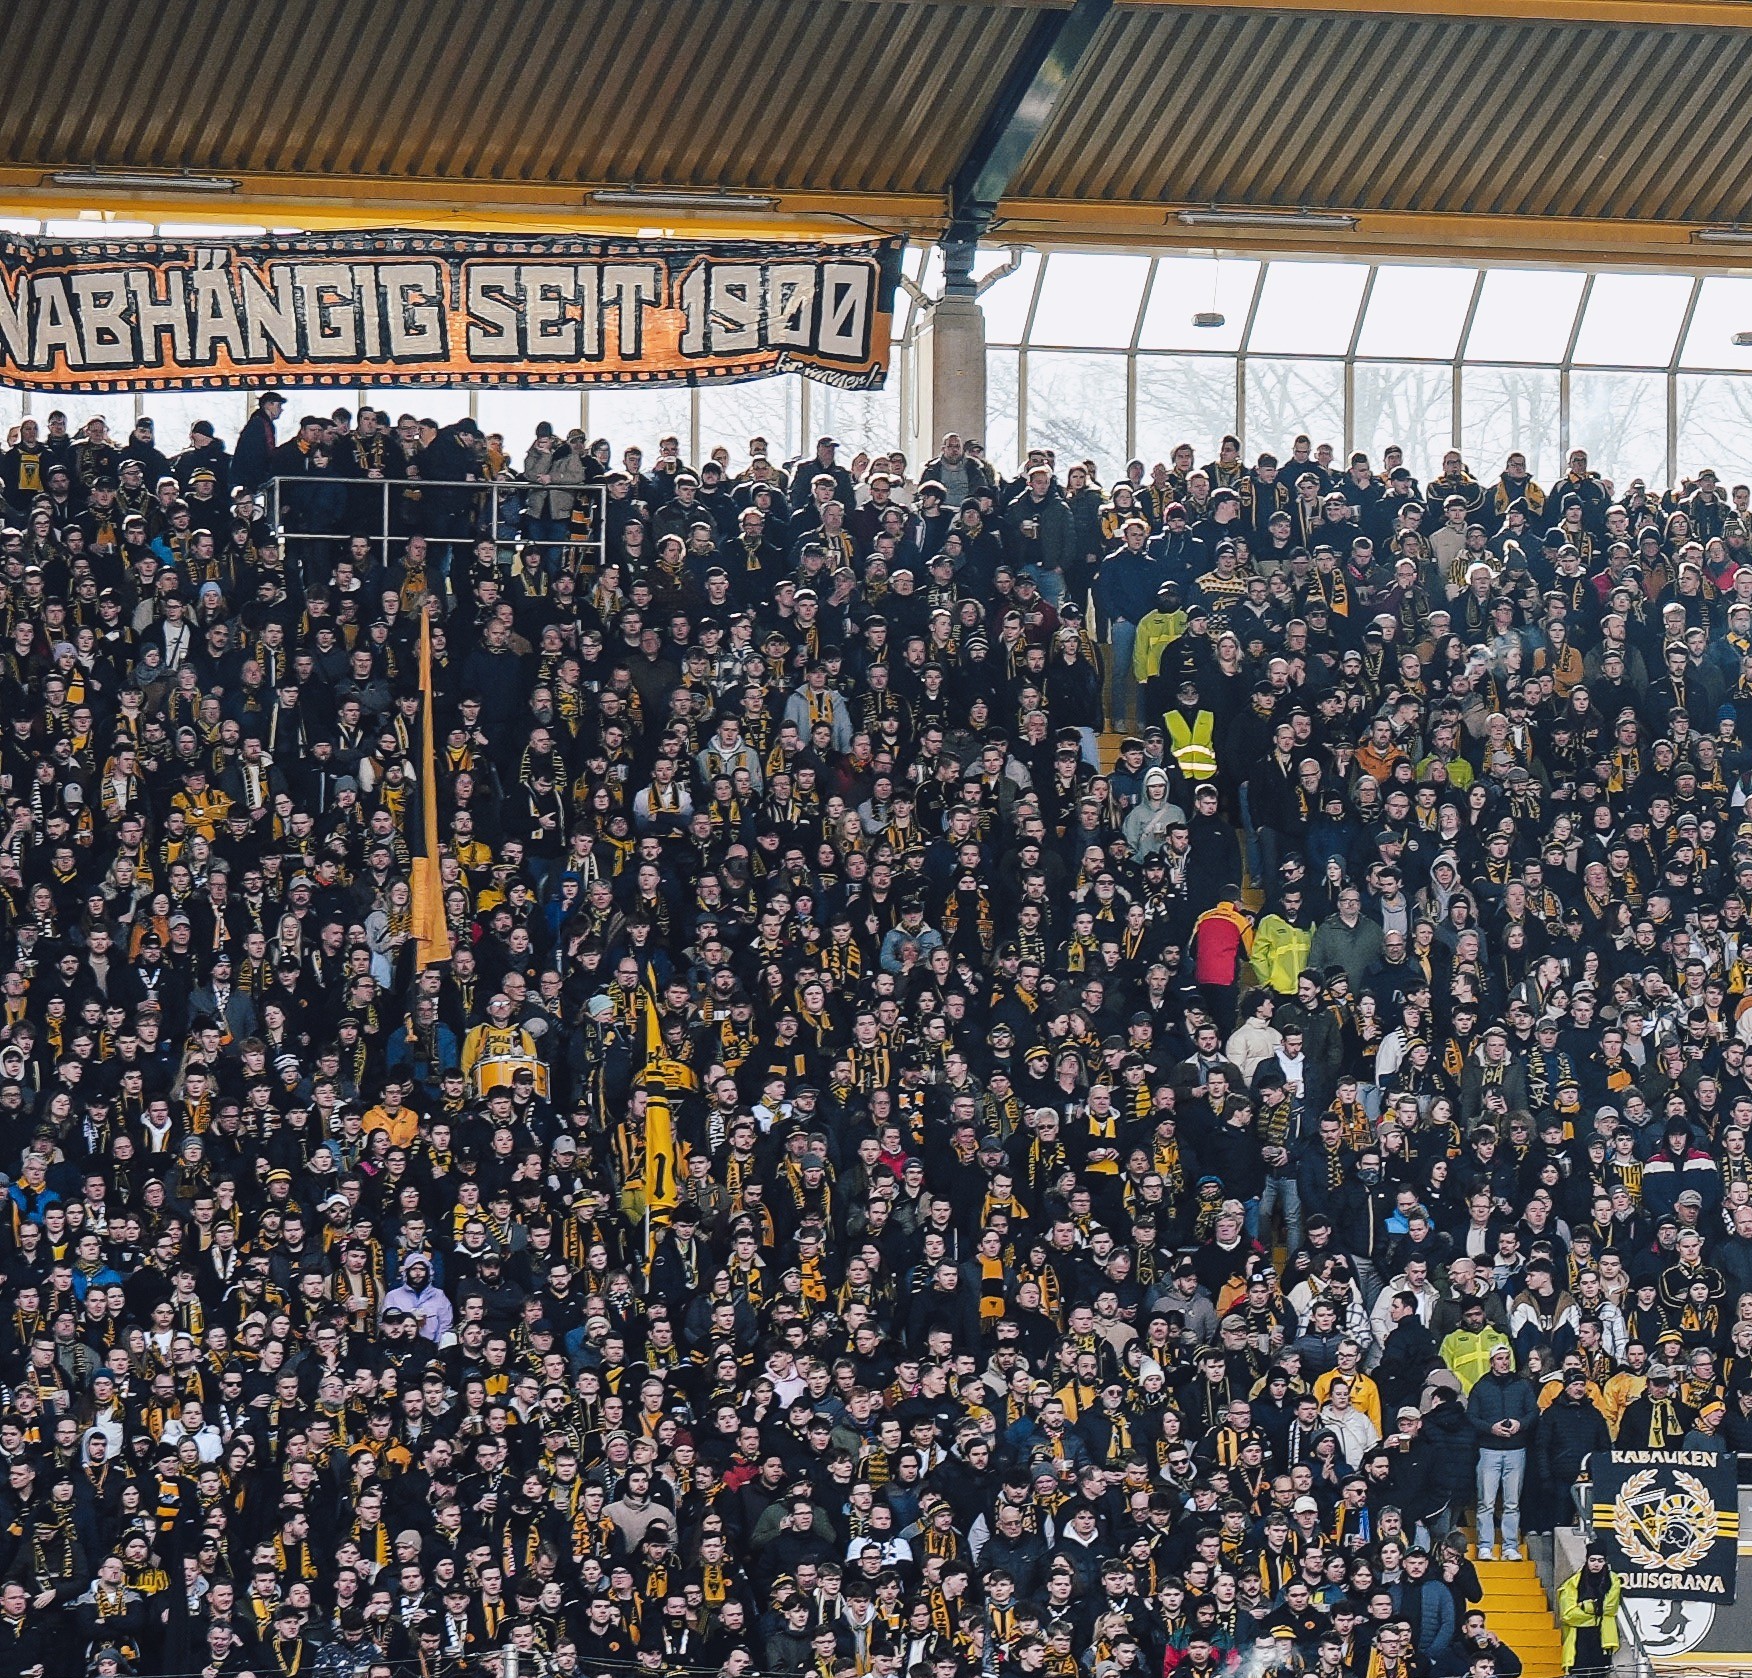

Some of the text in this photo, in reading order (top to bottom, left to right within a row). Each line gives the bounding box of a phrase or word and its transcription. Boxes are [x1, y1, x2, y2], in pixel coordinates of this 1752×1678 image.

[466, 262, 662, 358] SEIT
[678, 257, 873, 357] 1900
[1611, 1450, 1718, 1468] RABAUKEN
[1618, 1572, 1726, 1594] QUISGRANA
